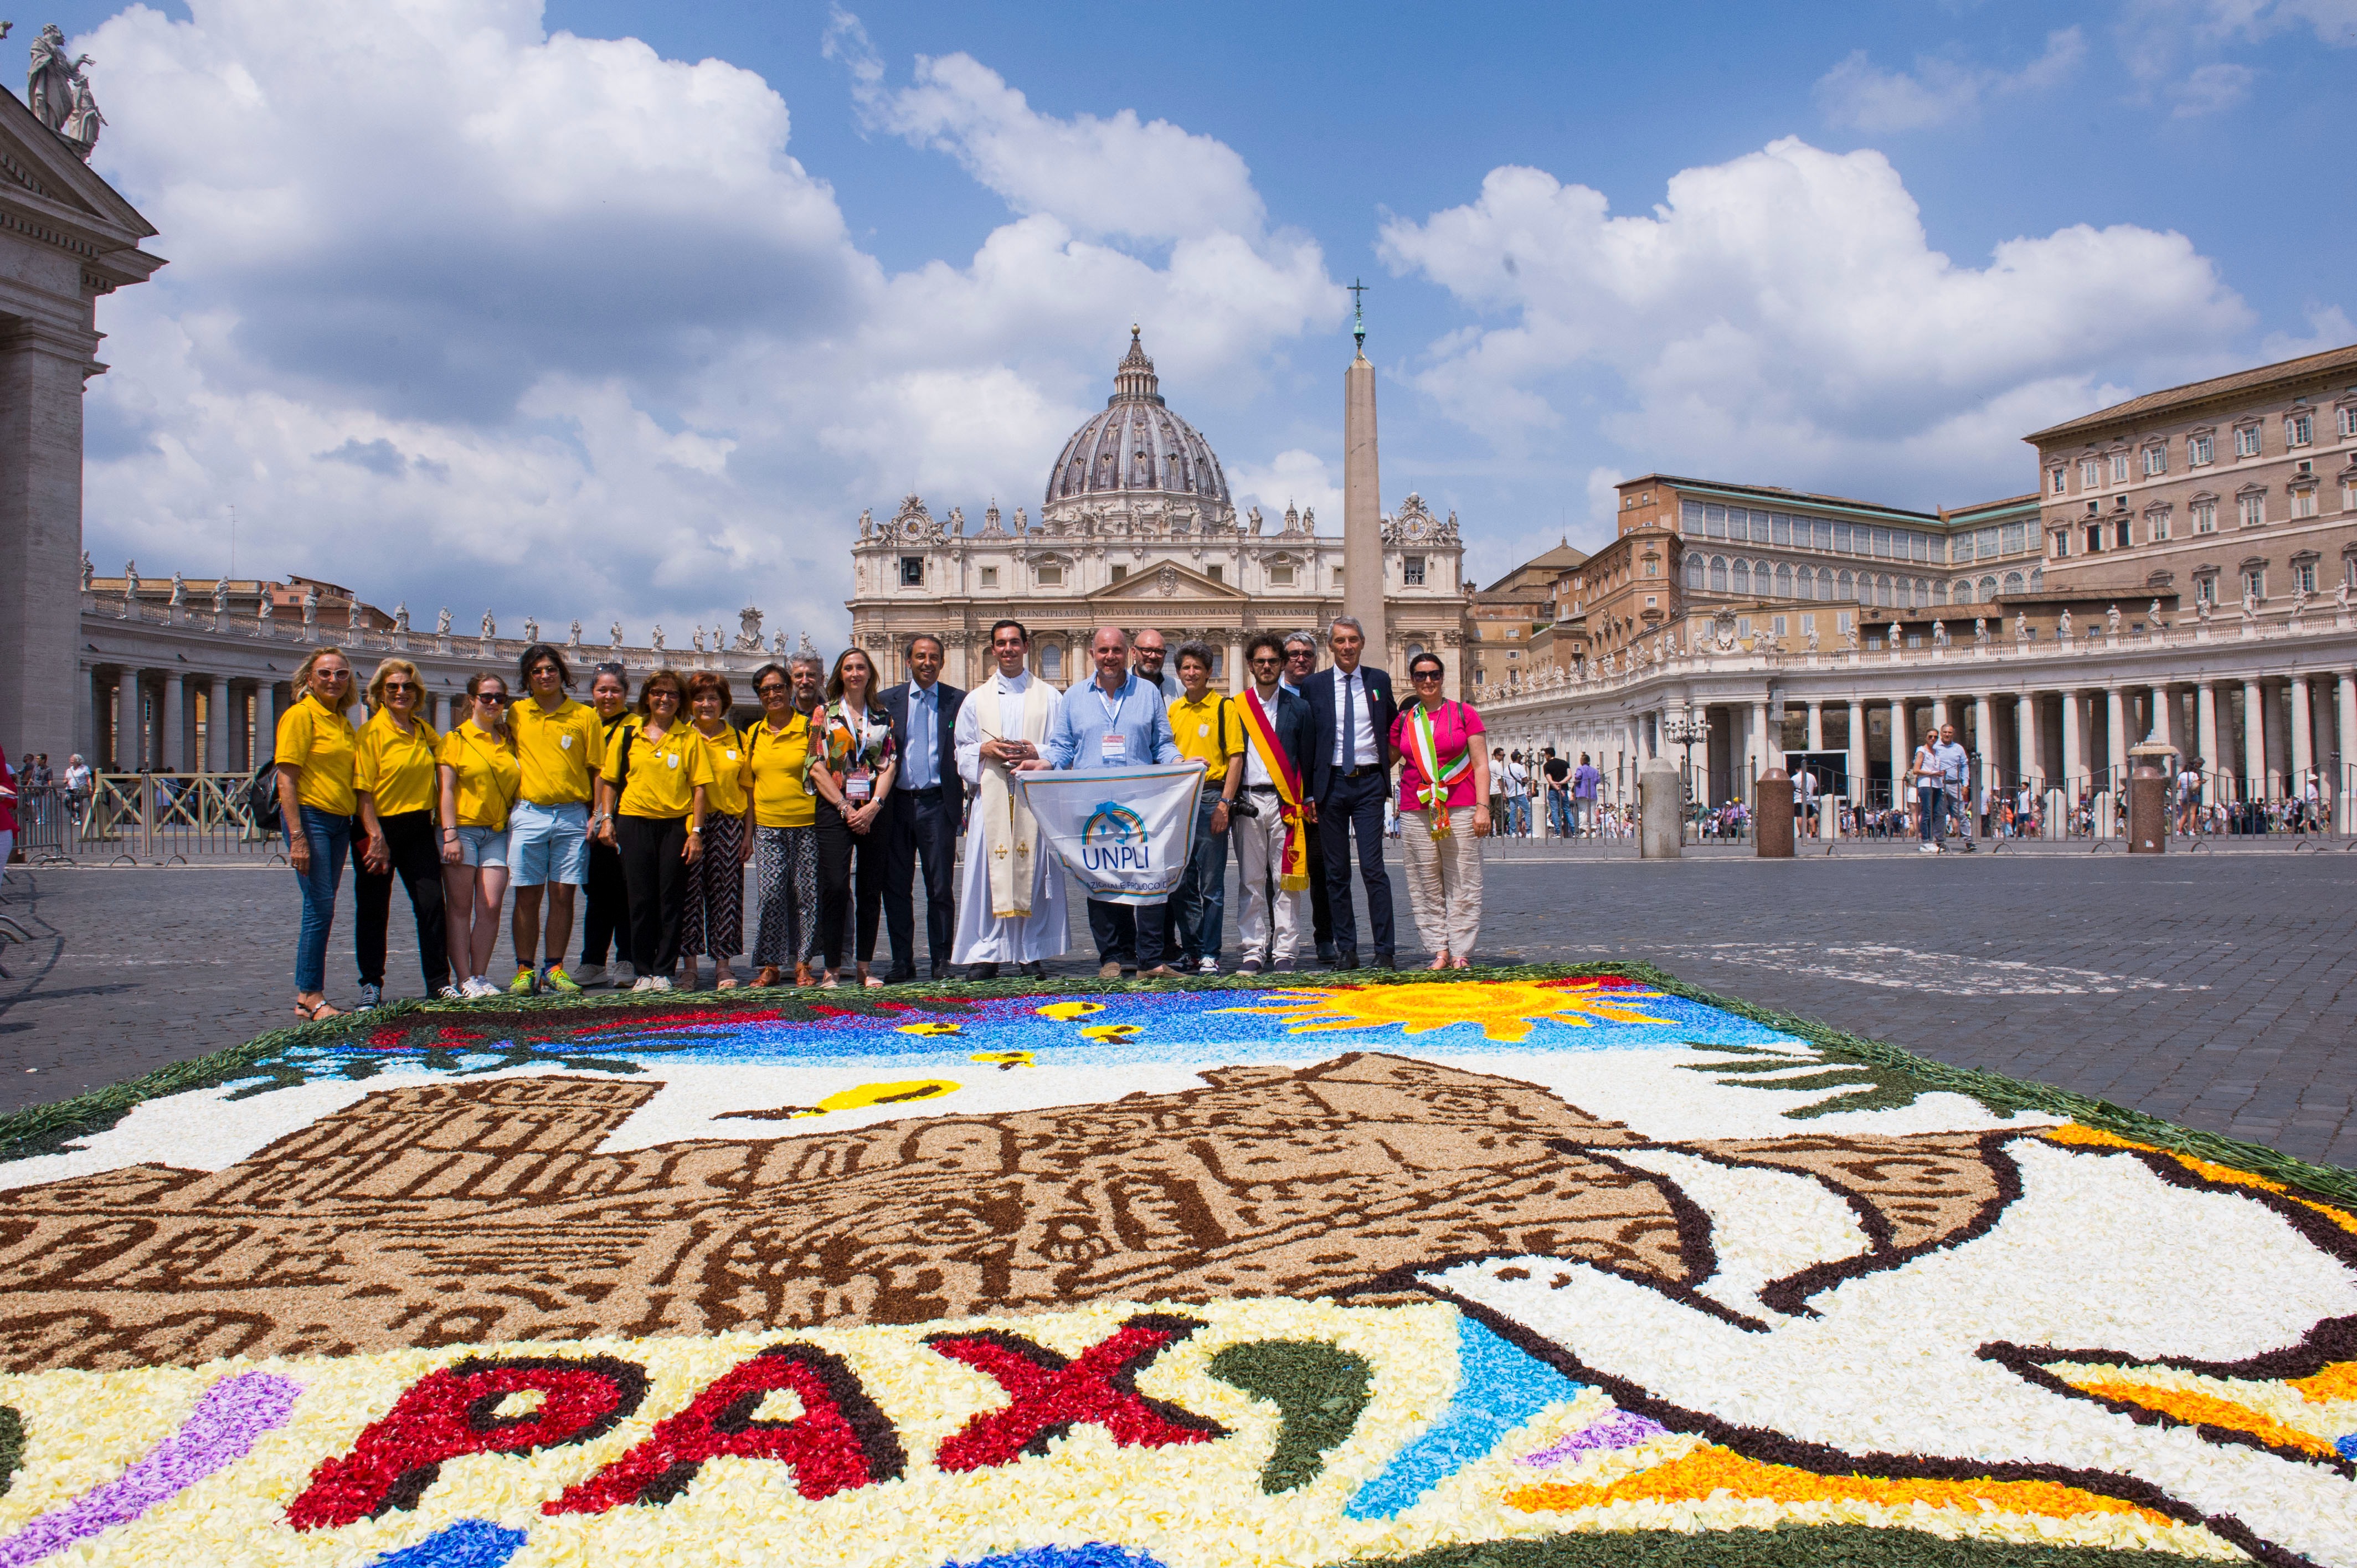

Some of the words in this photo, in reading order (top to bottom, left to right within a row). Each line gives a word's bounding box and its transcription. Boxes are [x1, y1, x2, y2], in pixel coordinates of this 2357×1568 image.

[965, 610, 1013, 618] HONOREM
[1083, 846, 1149, 870] UNPLI
[1086, 881, 1126, 890] AZIONALE
[285, 1311, 1237, 1533] PAX
